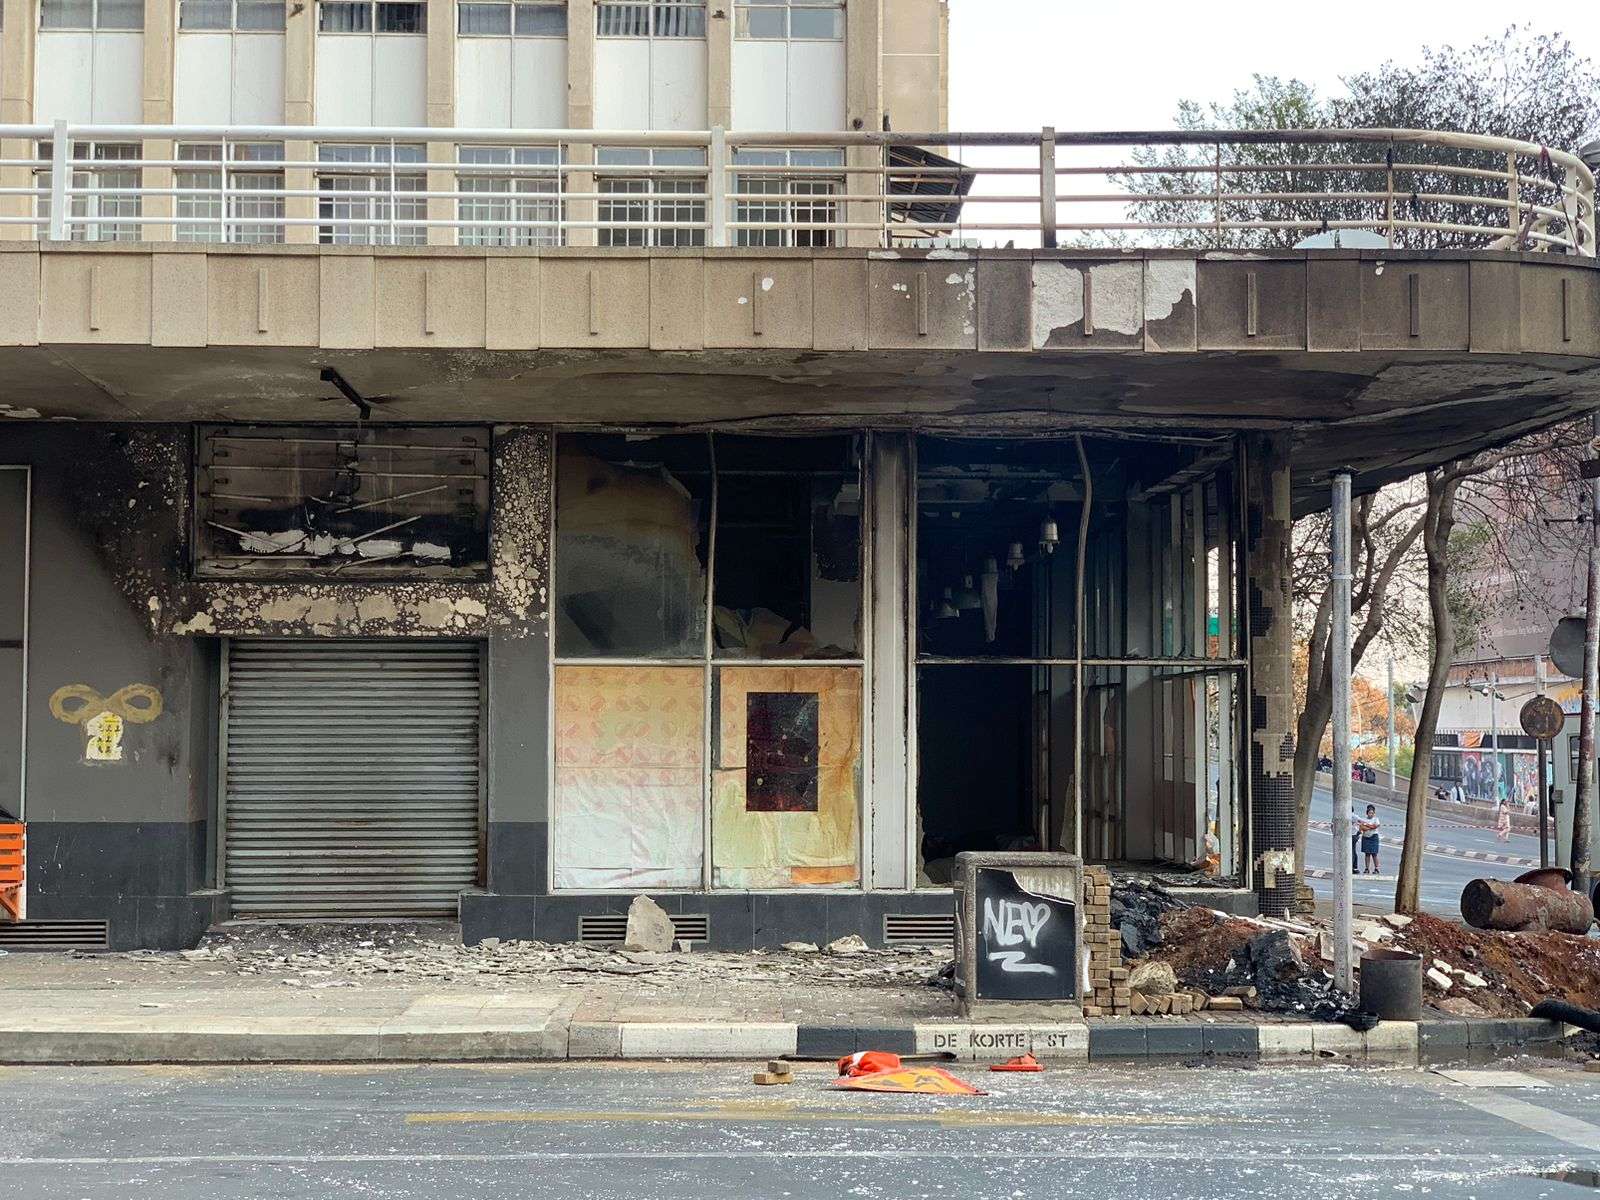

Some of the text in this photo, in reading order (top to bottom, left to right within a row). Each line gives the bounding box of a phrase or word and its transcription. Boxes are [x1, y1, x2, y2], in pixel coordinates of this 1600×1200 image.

[934, 1033, 1068, 1047] DE KORTE ST
